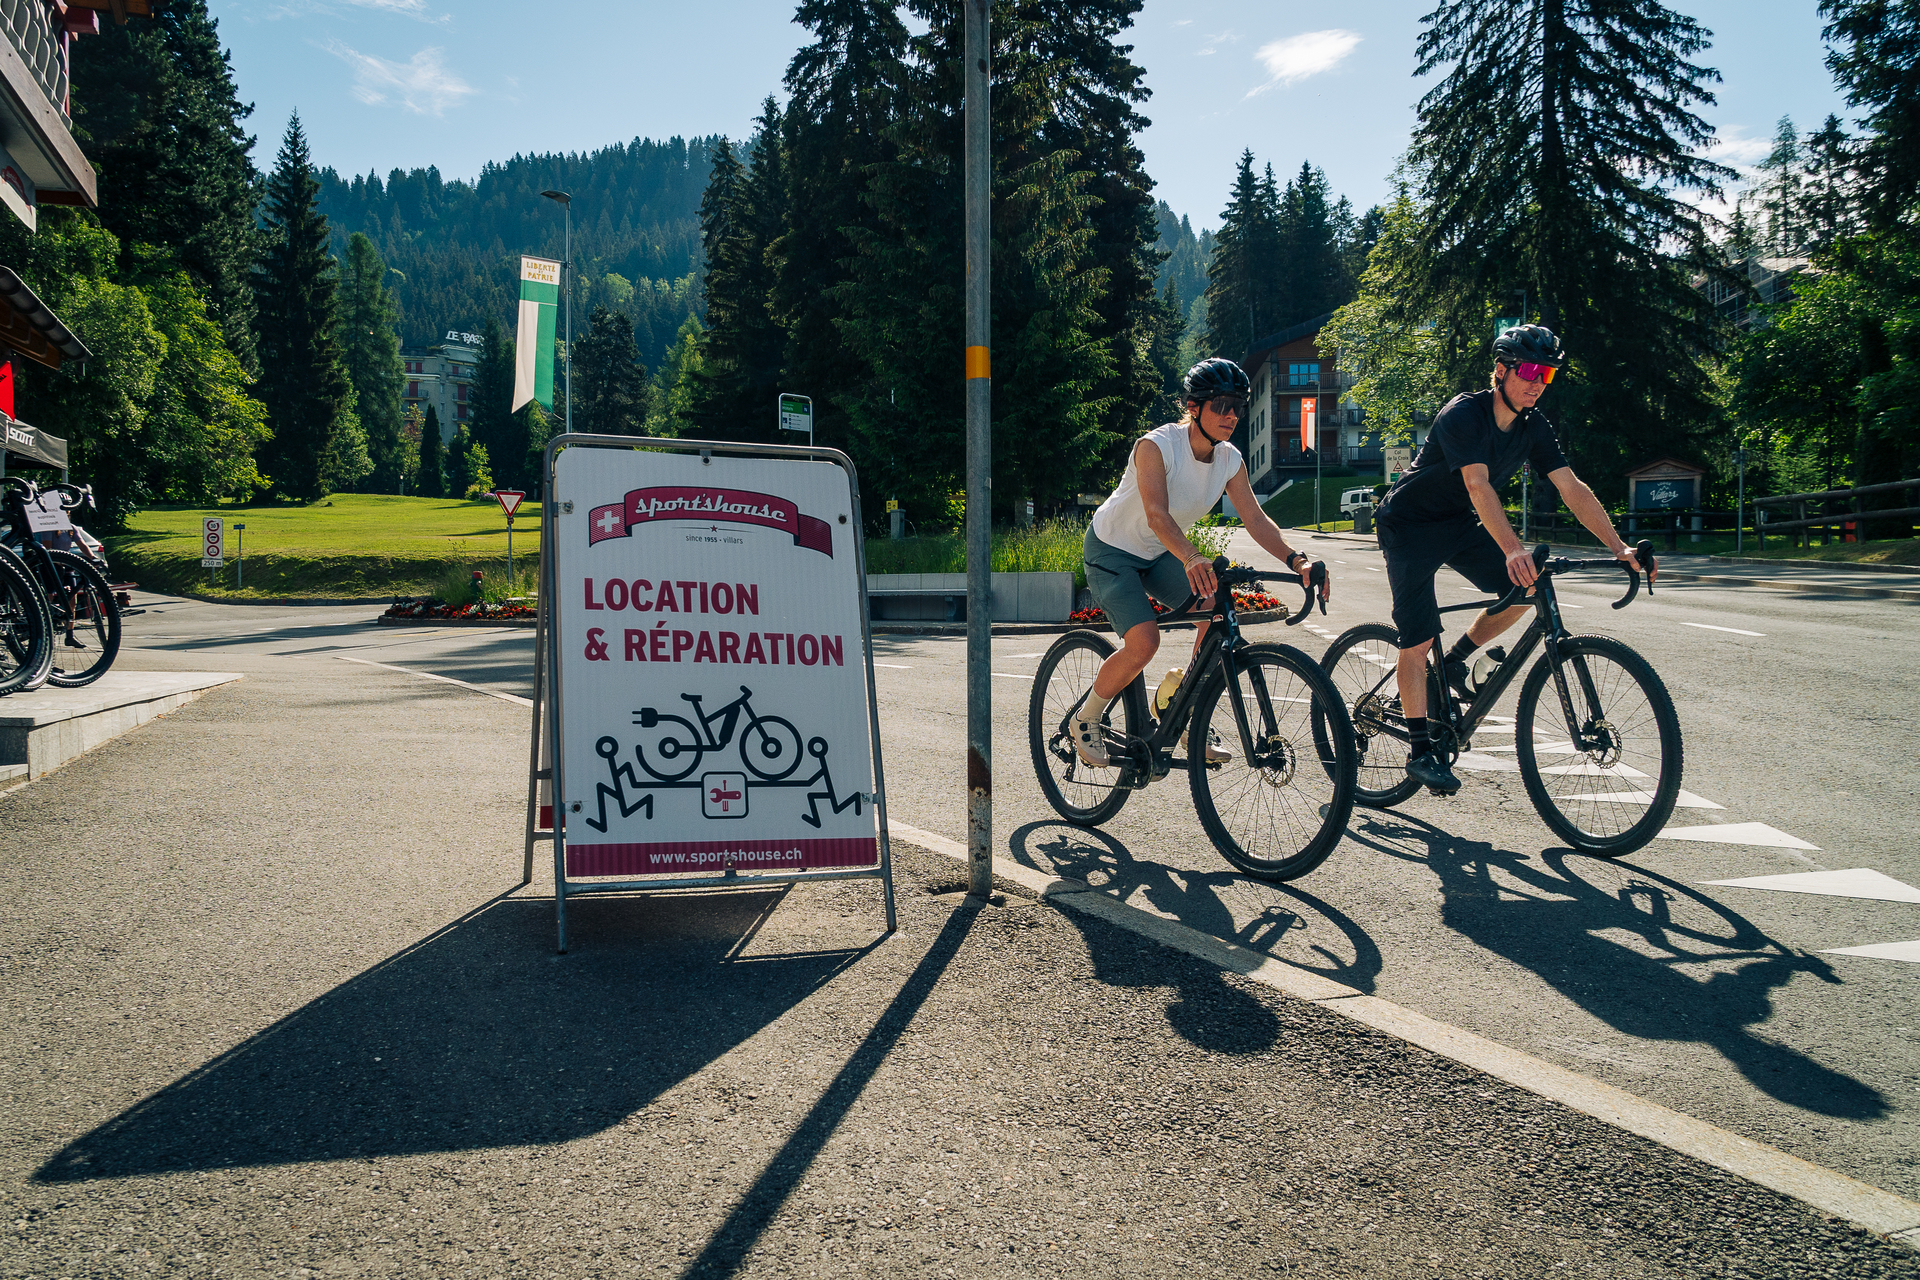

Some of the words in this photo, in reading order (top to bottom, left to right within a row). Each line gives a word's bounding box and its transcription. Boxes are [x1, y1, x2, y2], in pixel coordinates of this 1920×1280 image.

[526, 261, 556, 272] LIBERTÉ
[527, 272, 554, 282] PATRIE
[445, 330, 459, 341] LE
[9, 427, 34, 446] SCOTT
[685, 534, 703, 542] since
[723, 536, 744, 544] villars
[584, 577, 760, 616] LOCATION
[584, 627, 611, 662] &
[624, 620, 844, 667] RÉPARATION
[649, 847, 802, 865] www.sportshouse.ch
